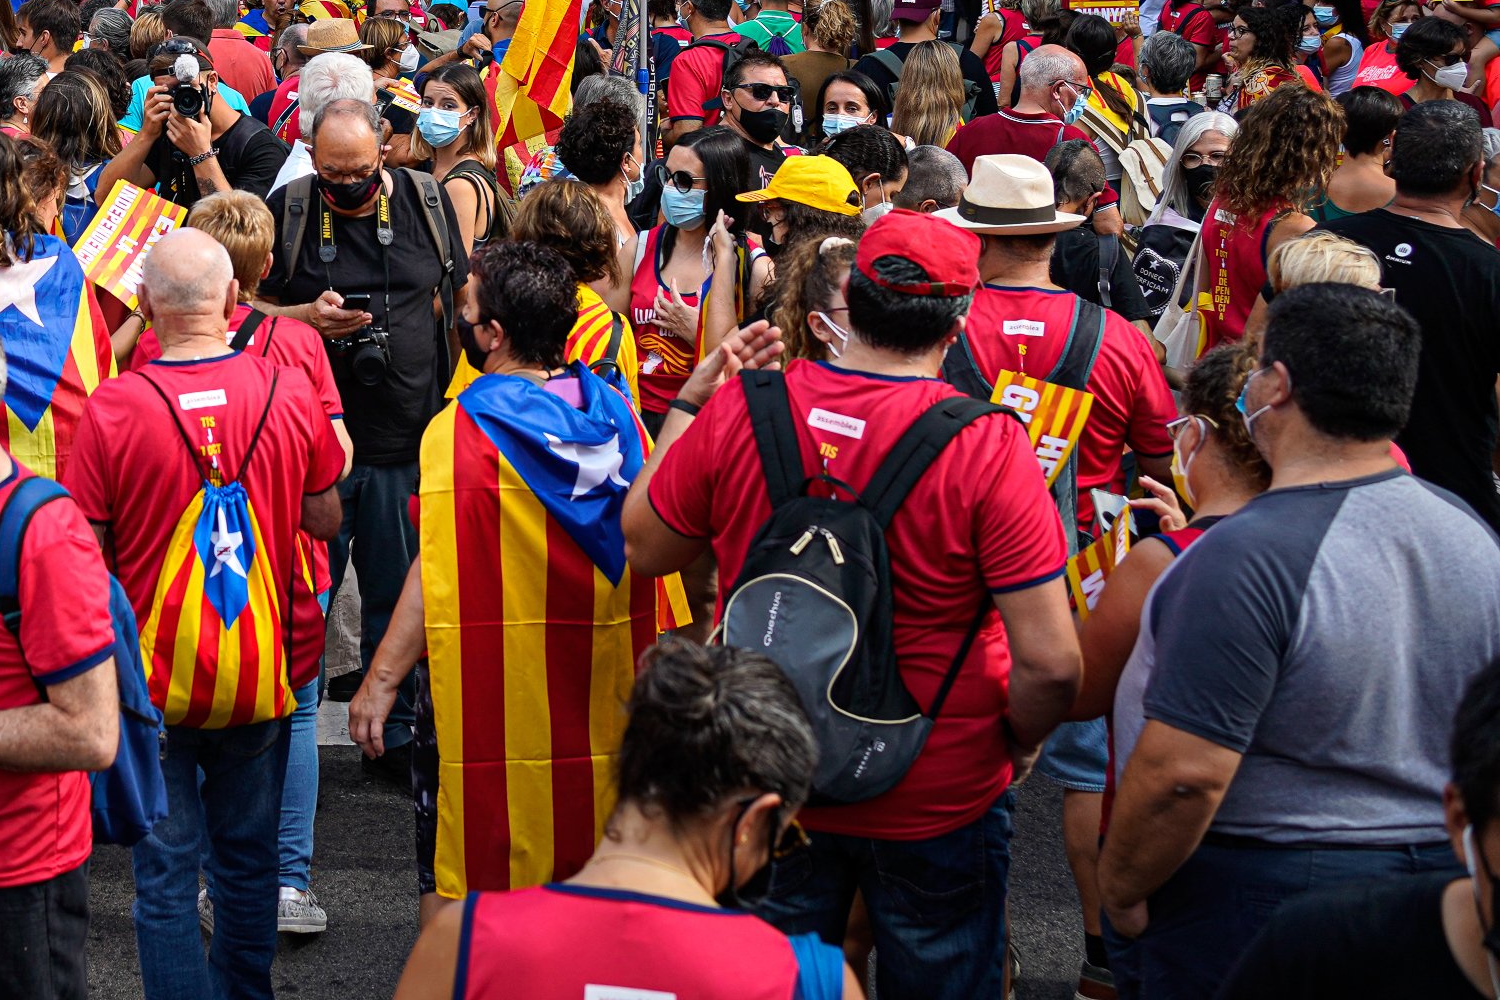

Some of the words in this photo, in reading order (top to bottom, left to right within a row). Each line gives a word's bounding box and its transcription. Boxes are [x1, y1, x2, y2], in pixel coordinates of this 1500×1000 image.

[647, 56, 657, 124] REPÚBLICA
[380, 194, 389, 223] Nikon
[322, 211, 332, 239] Nikon
[115, 234, 139, 255] LA
[1139, 266, 1165, 283] DONEC
[1218, 268, 1227, 278] IN
[1218, 277, 1228, 287] DE
[1214, 285, 1230, 296] PEN
[1217, 304, 1226, 313] CI
[1218, 312, 1224, 321] A
[1008, 324, 1040, 332] assemblea
[815, 413, 859, 432] assemblea
[207, 443, 222, 456] OCT
[763, 590, 781, 647] Quechua
